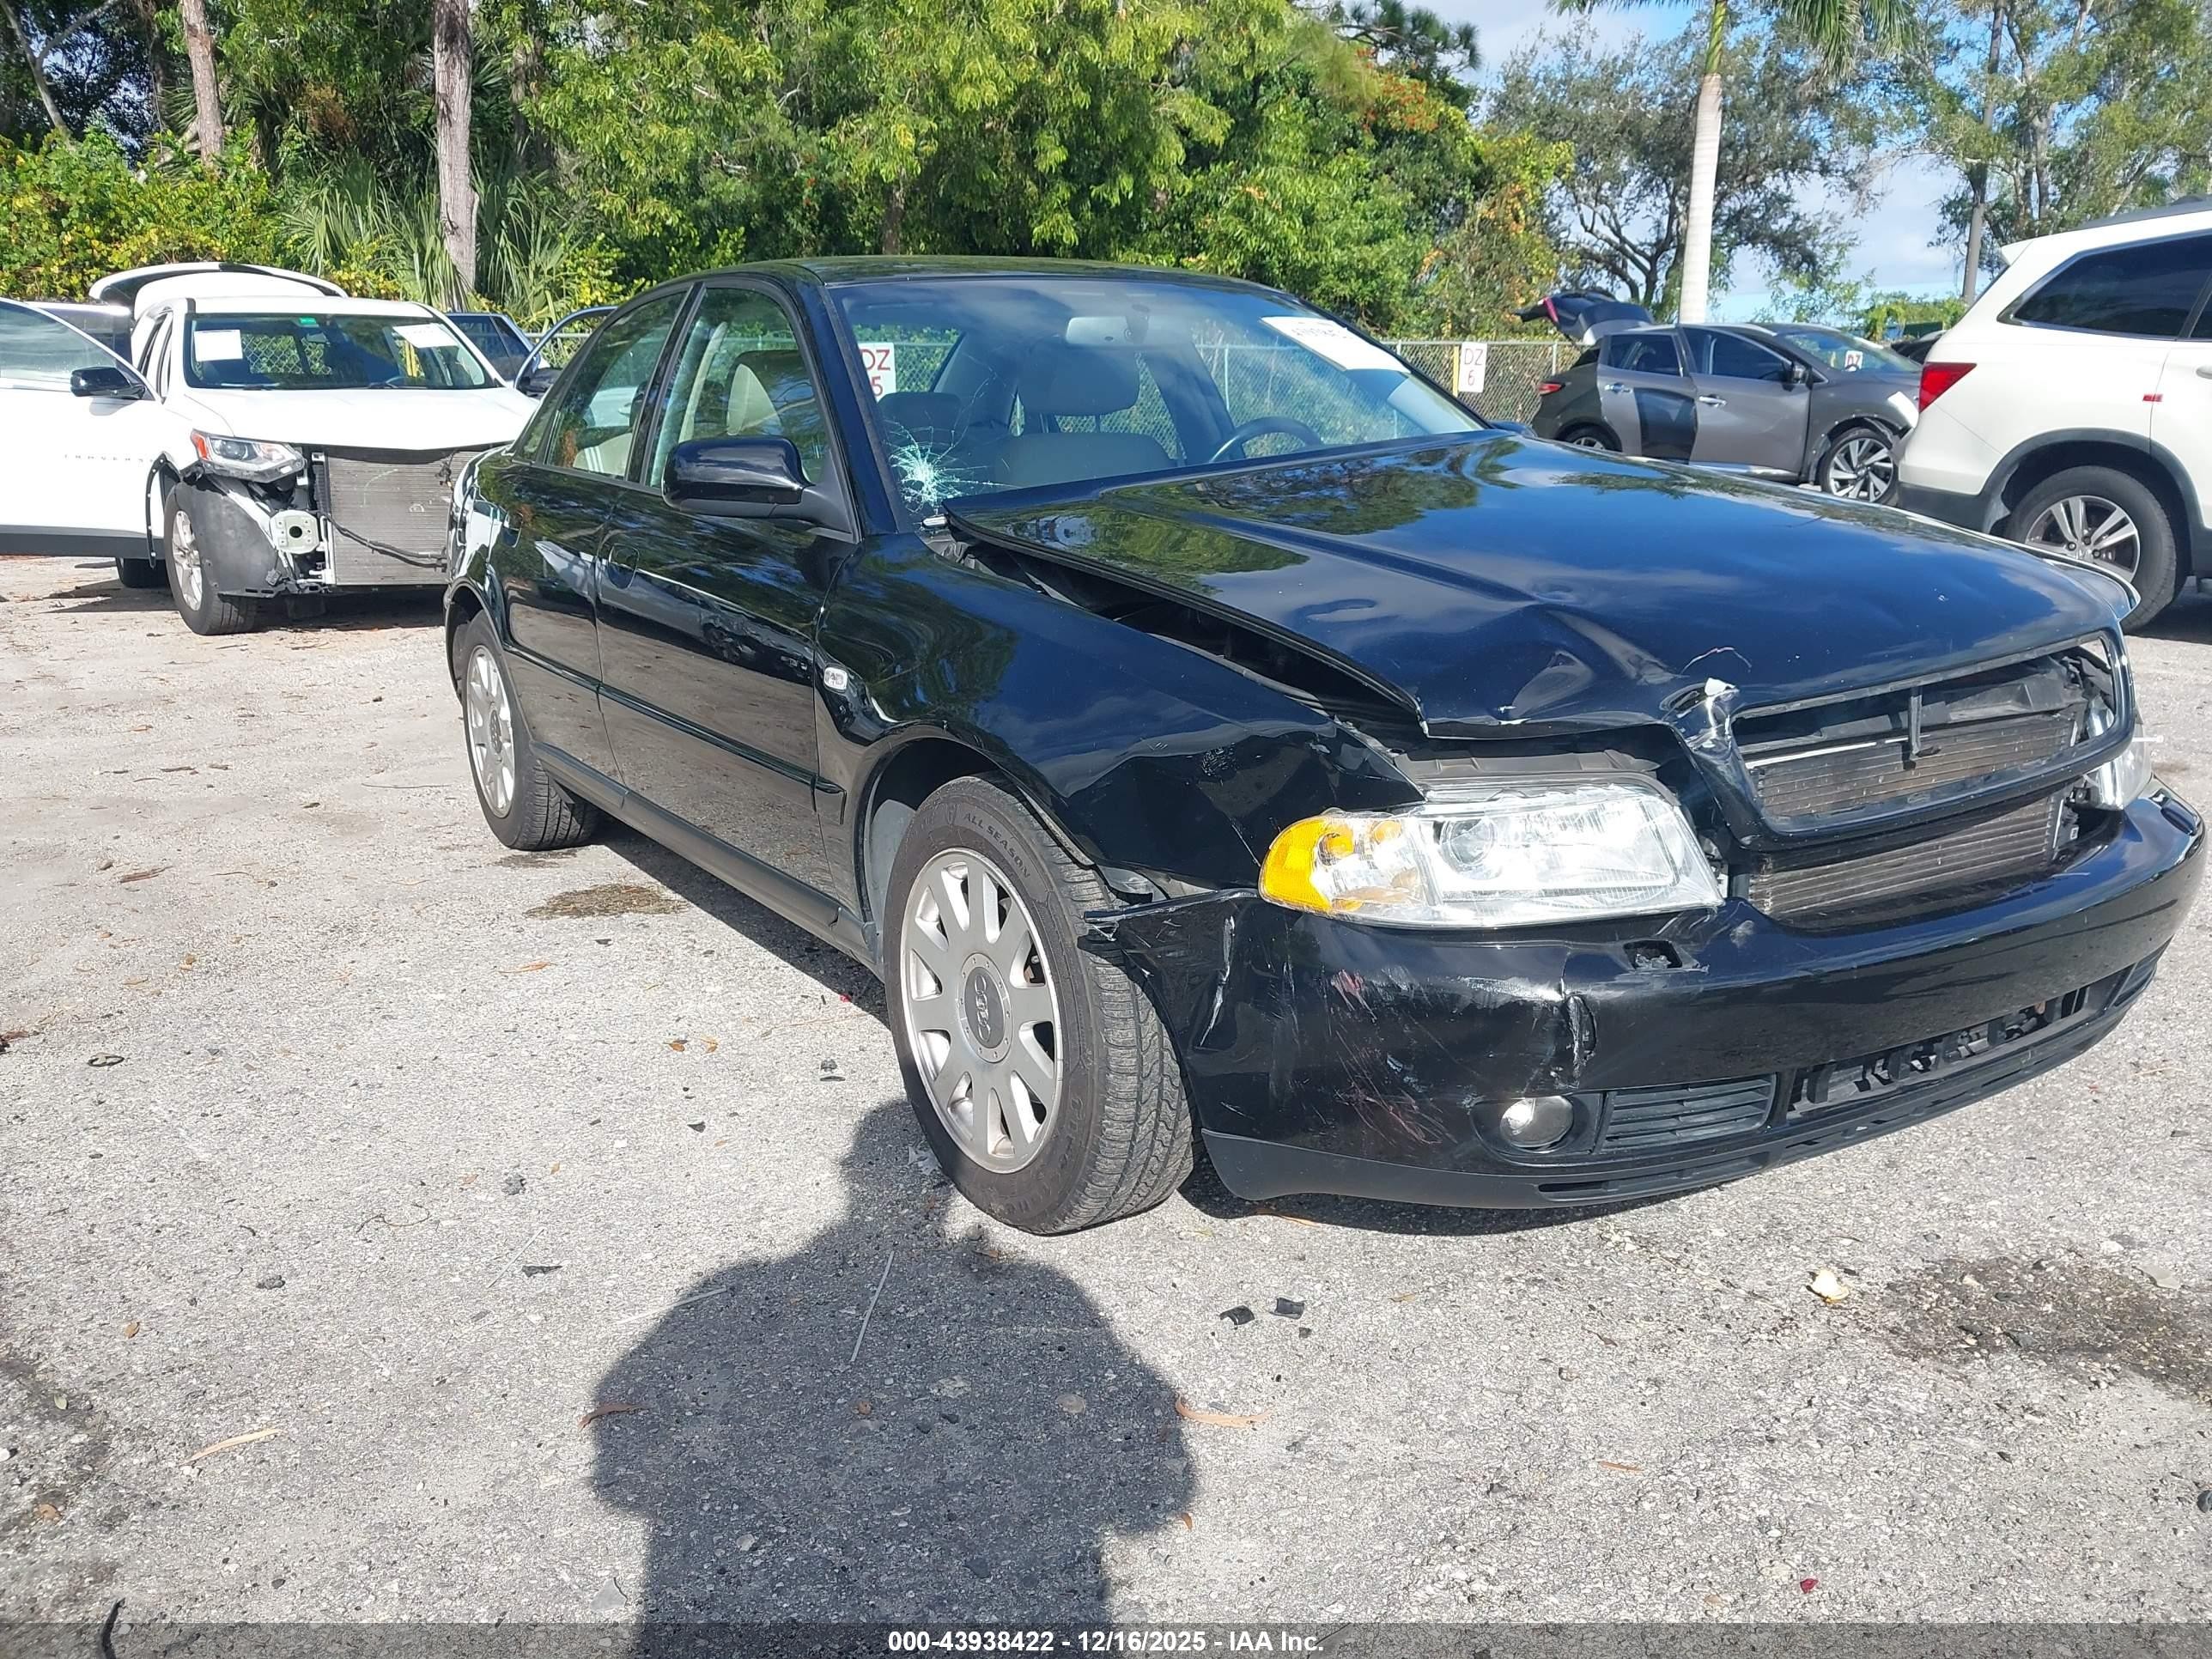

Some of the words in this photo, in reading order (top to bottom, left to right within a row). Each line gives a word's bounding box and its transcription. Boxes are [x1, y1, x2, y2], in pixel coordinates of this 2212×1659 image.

[860, 349, 890, 371] DZ
[1464, 348, 1484, 366] DZ
[1467, 369, 1476, 387] 6
[963, 812, 983, 829] ALL
[987, 825, 1030, 878] SEASON
